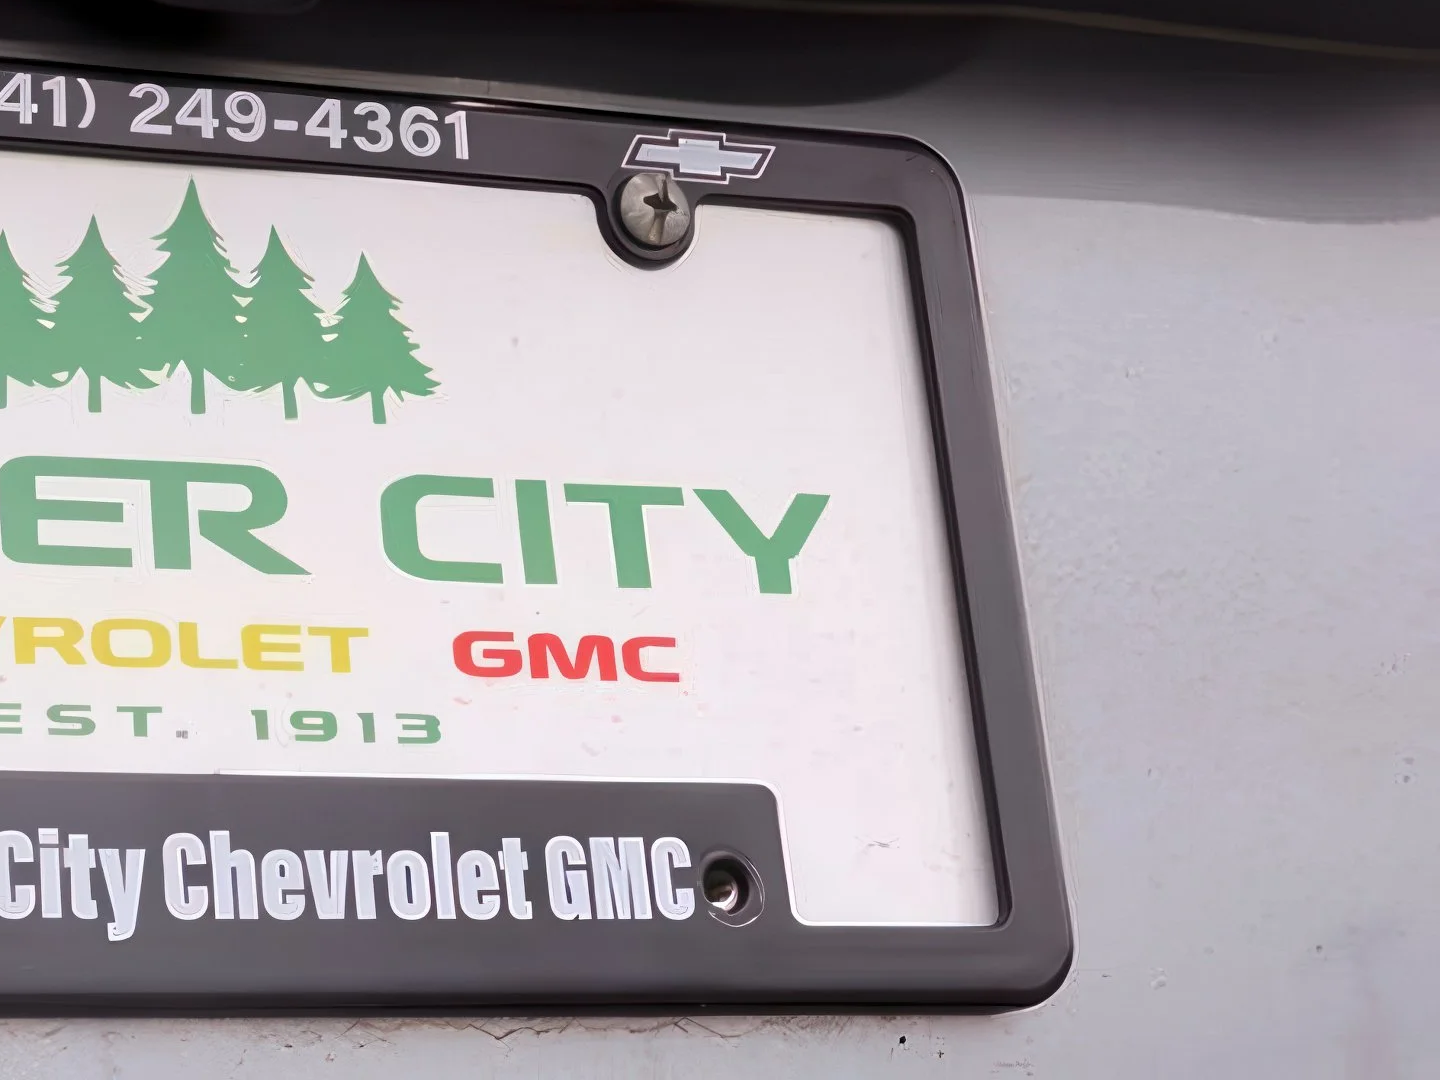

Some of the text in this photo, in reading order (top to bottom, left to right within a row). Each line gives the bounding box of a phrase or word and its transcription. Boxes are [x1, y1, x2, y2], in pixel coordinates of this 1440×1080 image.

[128, 82, 470, 161] 249-4361
[379, 473, 831, 595] CITY
[451, 630, 681, 683] GMC
[250, 709, 442, 745] 1913
[162, 830, 534, 921] Chevrolet
[545, 835, 696, 922] GMC
